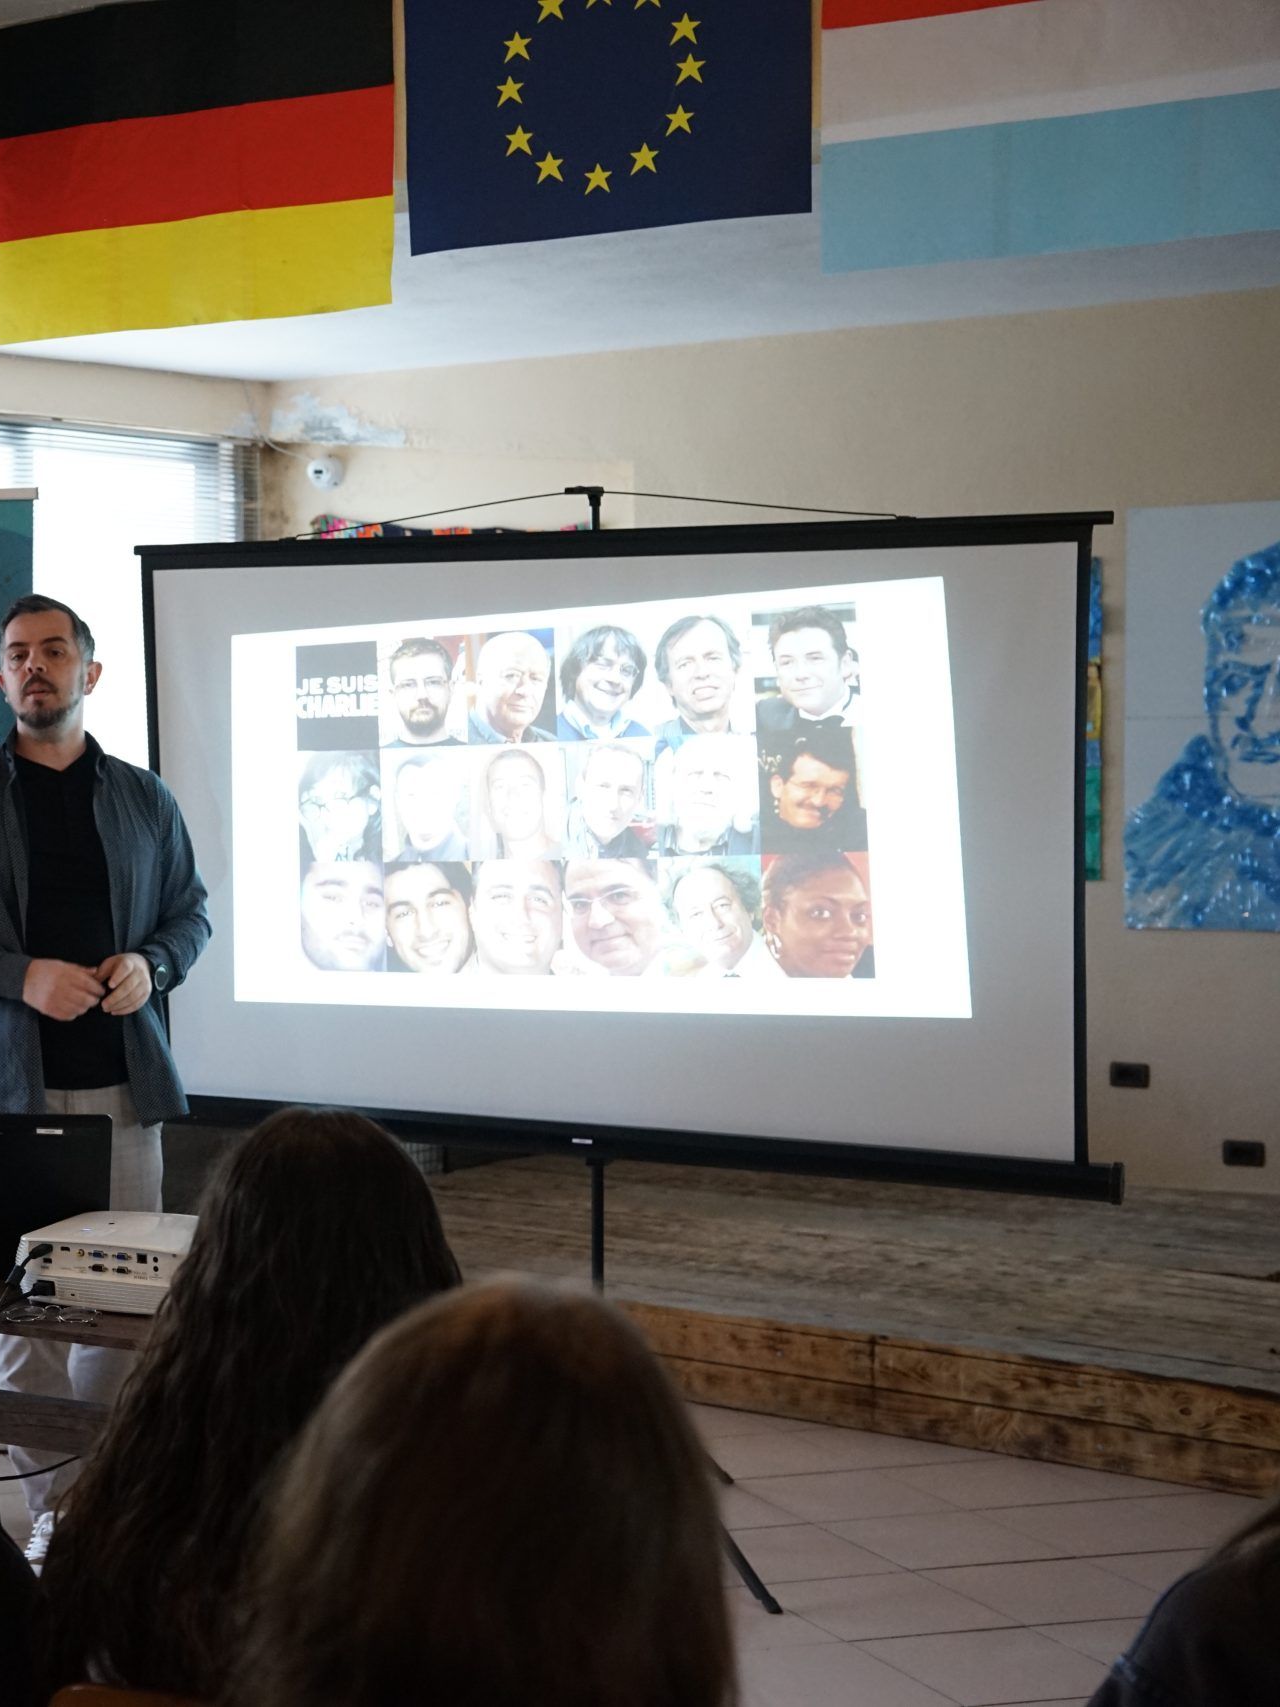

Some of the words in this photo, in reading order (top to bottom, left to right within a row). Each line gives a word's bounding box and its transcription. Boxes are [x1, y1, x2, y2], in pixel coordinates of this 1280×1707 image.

[296, 677, 324, 695] JE
[326, 674, 378, 694] SUIS
[296, 693, 378, 719] CHARLIE
